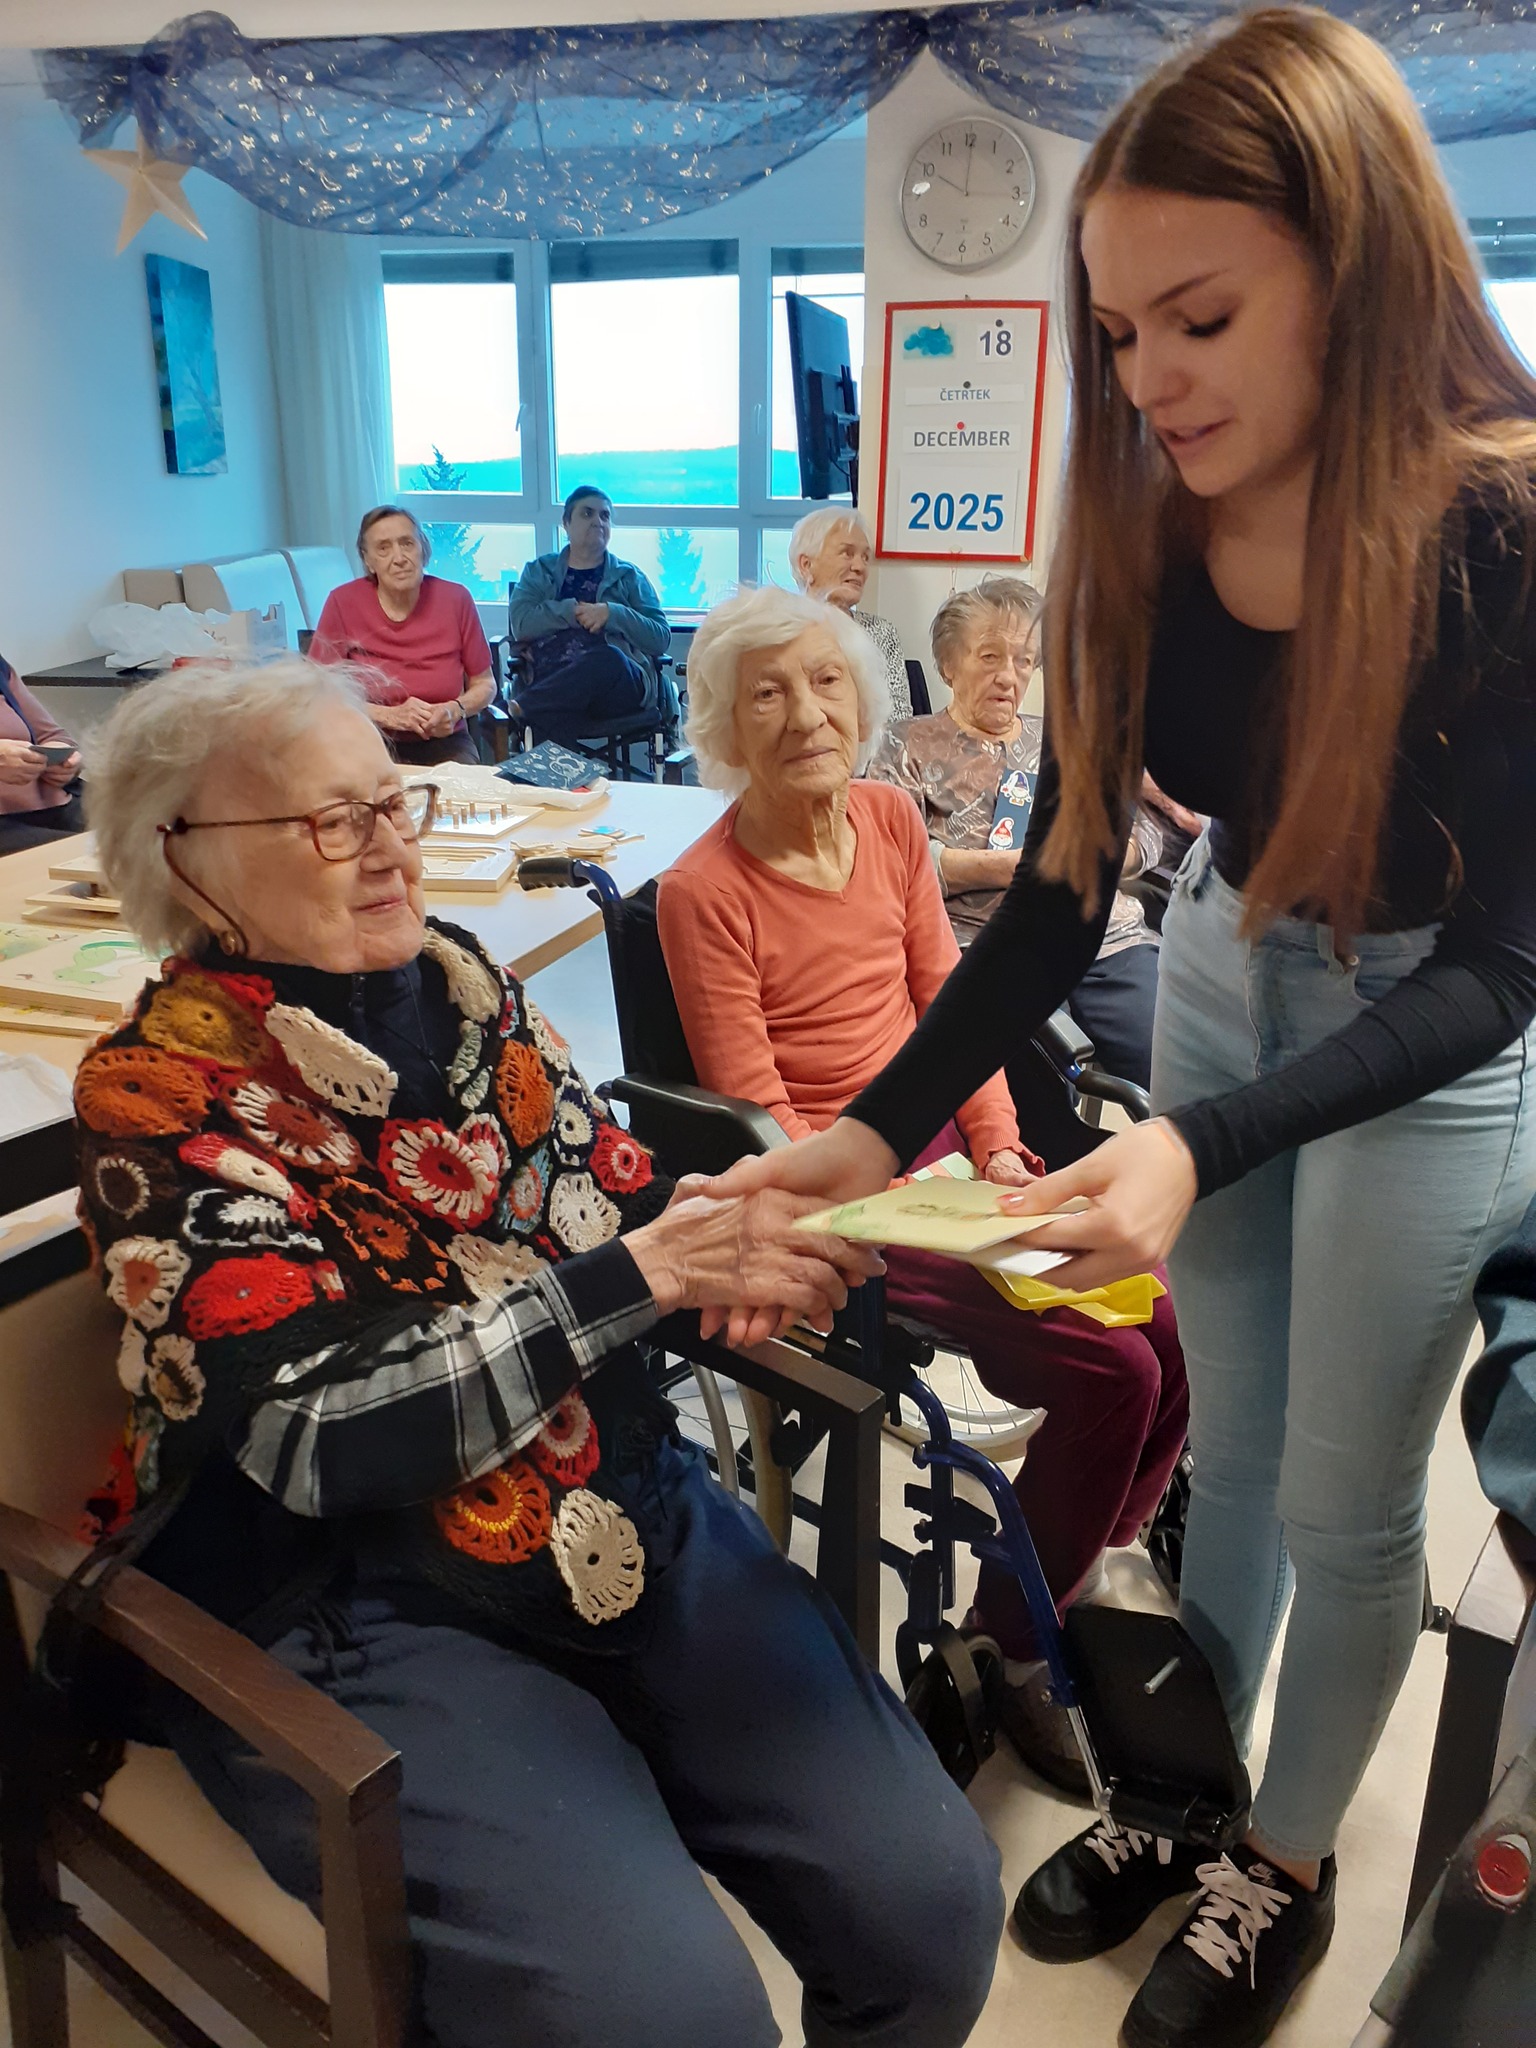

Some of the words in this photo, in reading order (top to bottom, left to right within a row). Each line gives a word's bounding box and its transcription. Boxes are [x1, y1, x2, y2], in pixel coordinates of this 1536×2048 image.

[965, 133, 977, 147] 12
[942, 142, 952, 155] 11
[923, 163, 935, 177] 10
[1006, 160, 1015, 173] 2
[1012, 186, 1021, 200] 3
[919, 214, 928, 227] 8
[1002, 214, 1010, 226] 4
[936, 232, 944, 245] 7
[982, 232, 991, 245] 5
[958, 240, 966, 253] 6
[980, 330, 1012, 356] 18
[940, 388, 991, 401] ČETRTEK
[914, 431, 1010, 447] DECEMBER
[908, 492, 1004, 532] 2025
